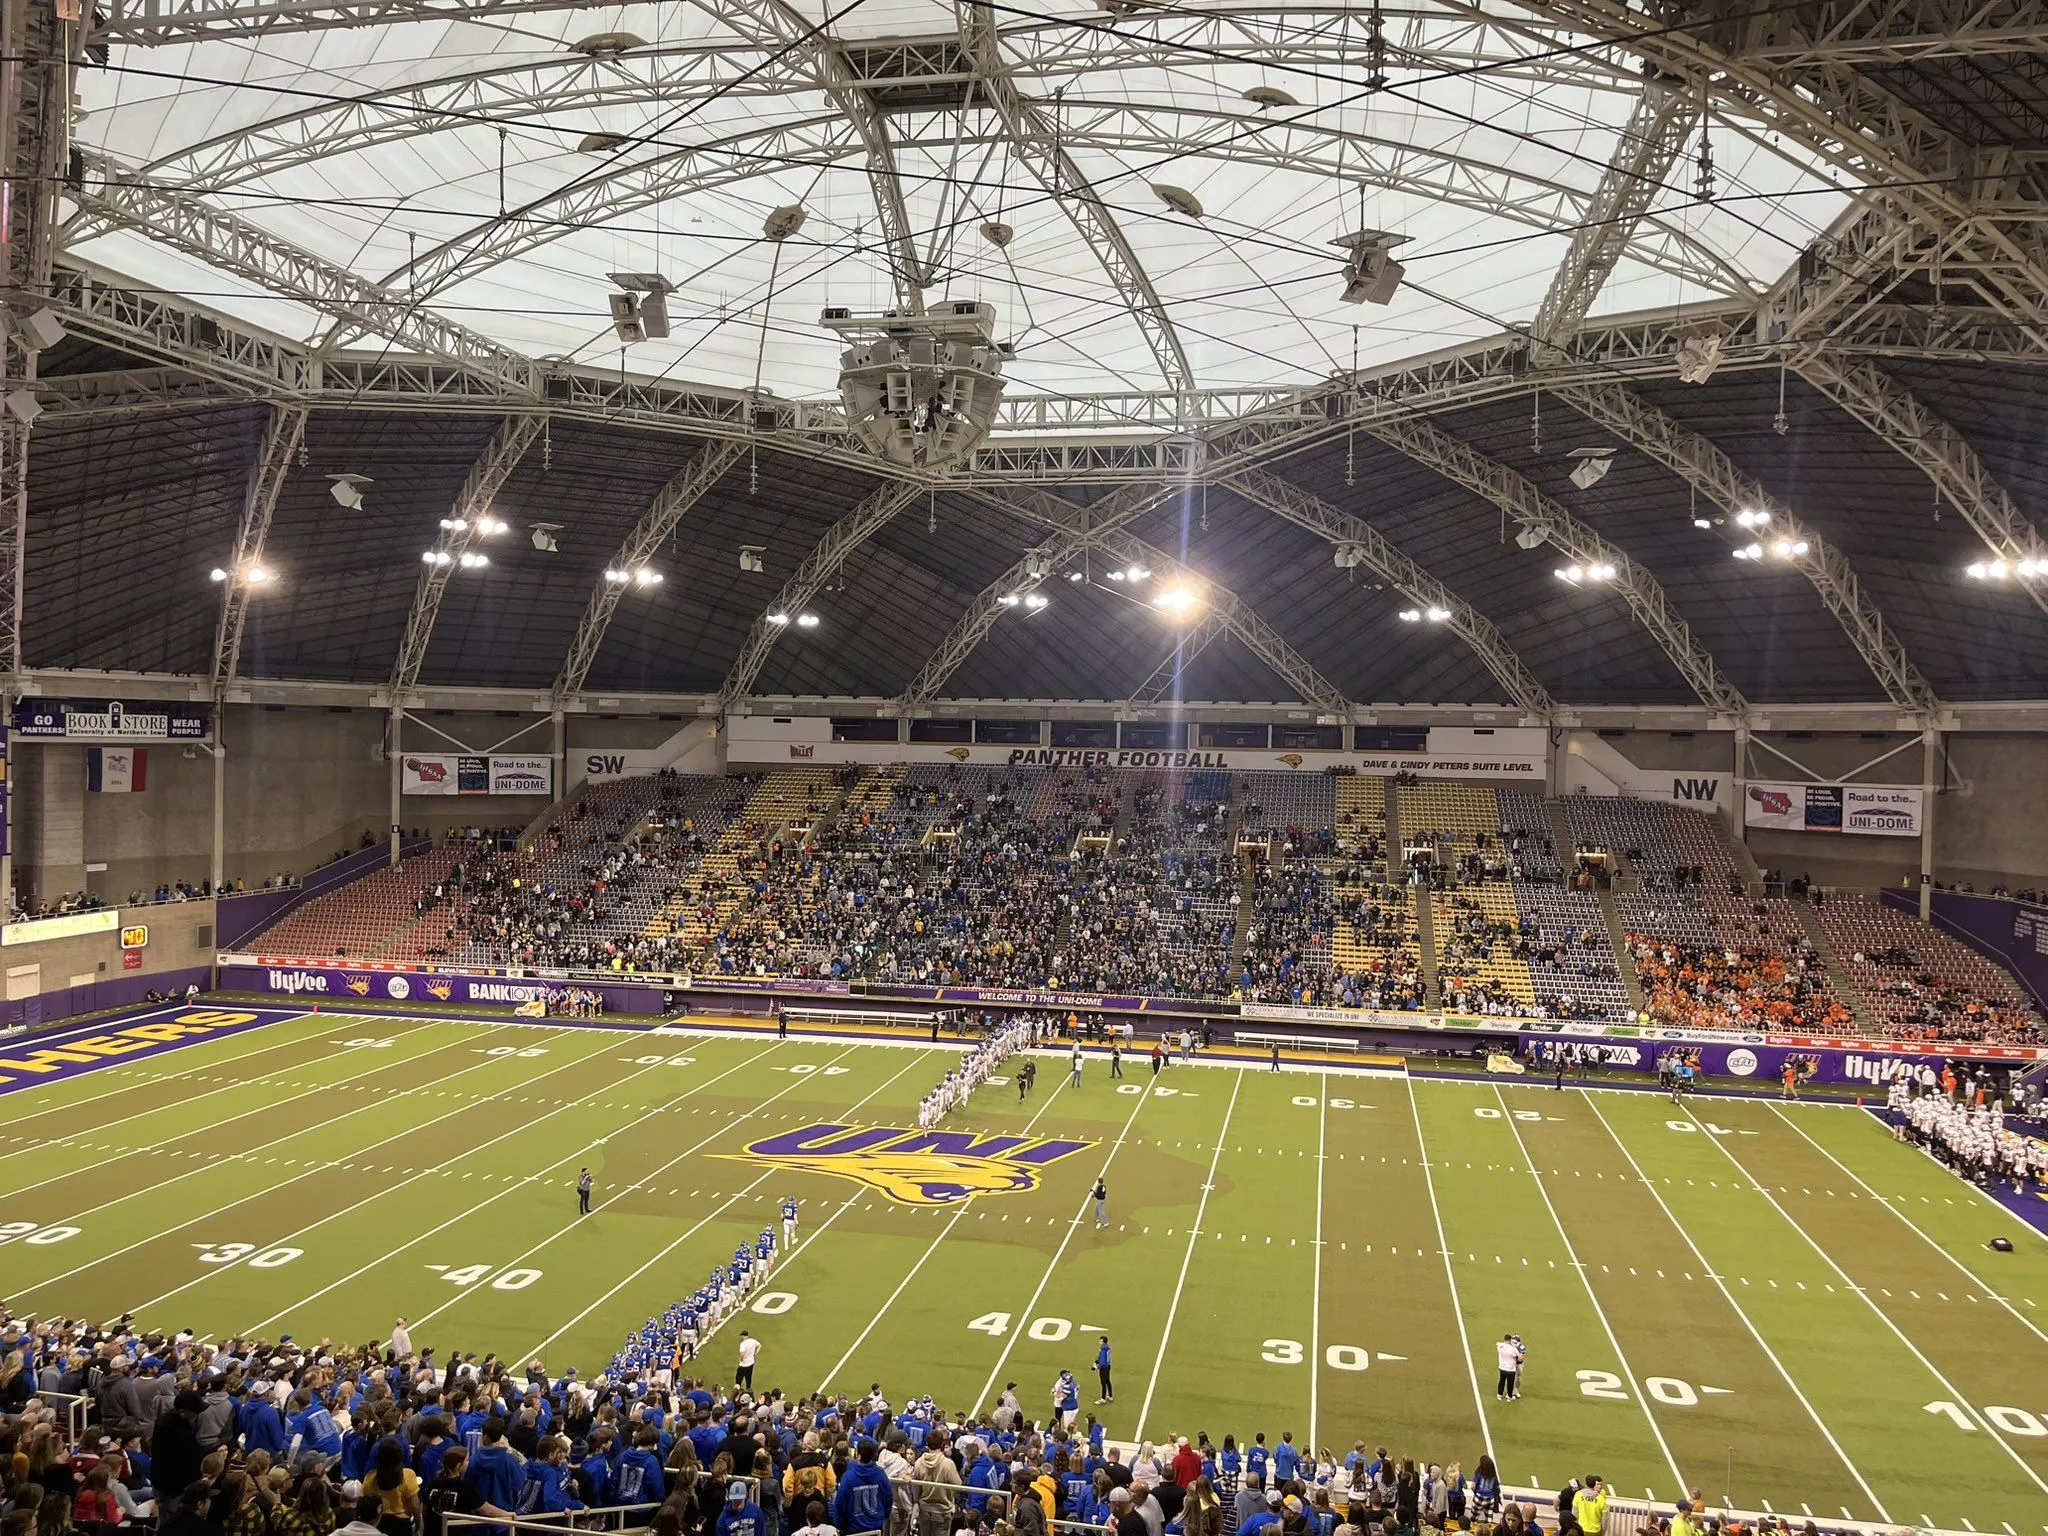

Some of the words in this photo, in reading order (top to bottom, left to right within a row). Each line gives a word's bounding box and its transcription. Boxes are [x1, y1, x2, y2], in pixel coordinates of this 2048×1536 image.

[34, 715, 53, 726] GO
[68, 714, 107, 729] BOOK
[124, 716, 167, 729] STORE
[172, 719, 200, 728] WEAR
[22, 726, 65, 734] PANTHERS!
[68, 728, 104, 736] University
[493, 760, 514, 769] Road
[516, 761, 525, 769] to
[586, 755, 625, 774] SW
[1012, 749, 1108, 766] PANTHER
[1118, 752, 1228, 768] FOOTBALL
[1363, 760, 1388, 768] DAVE
[1400, 761, 1430, 769] CINDY
[1432, 762, 1469, 770] PETERS
[1472, 763, 1500, 771] SUITE
[1503, 763, 1533, 771] LEVEL
[494, 780, 546, 790] UNI-DOME
[1674, 779, 1718, 800] NW
[1848, 792, 1874, 802] Road
[1877, 793, 1889, 802] to
[1849, 817, 1914, 829] UNI-DOME
[348, 975, 371, 986] UNI
[429, 979, 453, 989] UNI
[469, 983, 510, 1000] BANK
[978, 992, 1022, 1001] WELCOME
[1025, 994, 1036, 1002] TO
[1039, 994, 1056, 1003] THE
[1058, 996, 1103, 1006] UNI-DOME
[1316, 1011, 1343, 1019] SPECIALIZE
[1530, 1023, 1553, 1031] Veridian
[1687, 1032, 1740, 1040] BuyFordNow.com
[0, 1012, 258, 1085] HERS
[1729, 1056, 1755, 1068] cfu
[743, 1122, 1103, 1165] UNI
[199, 1242, 306, 1268] 30
[440, 1264, 544, 1290] 40
[967, 1311, 1073, 1342] 40
[1261, 1338, 1370, 1371] 30
[660, 1356, 672, 1366] 57
[1575, 1369, 1699, 1406] 20
[1922, 1400, 2046, 1436] 10
